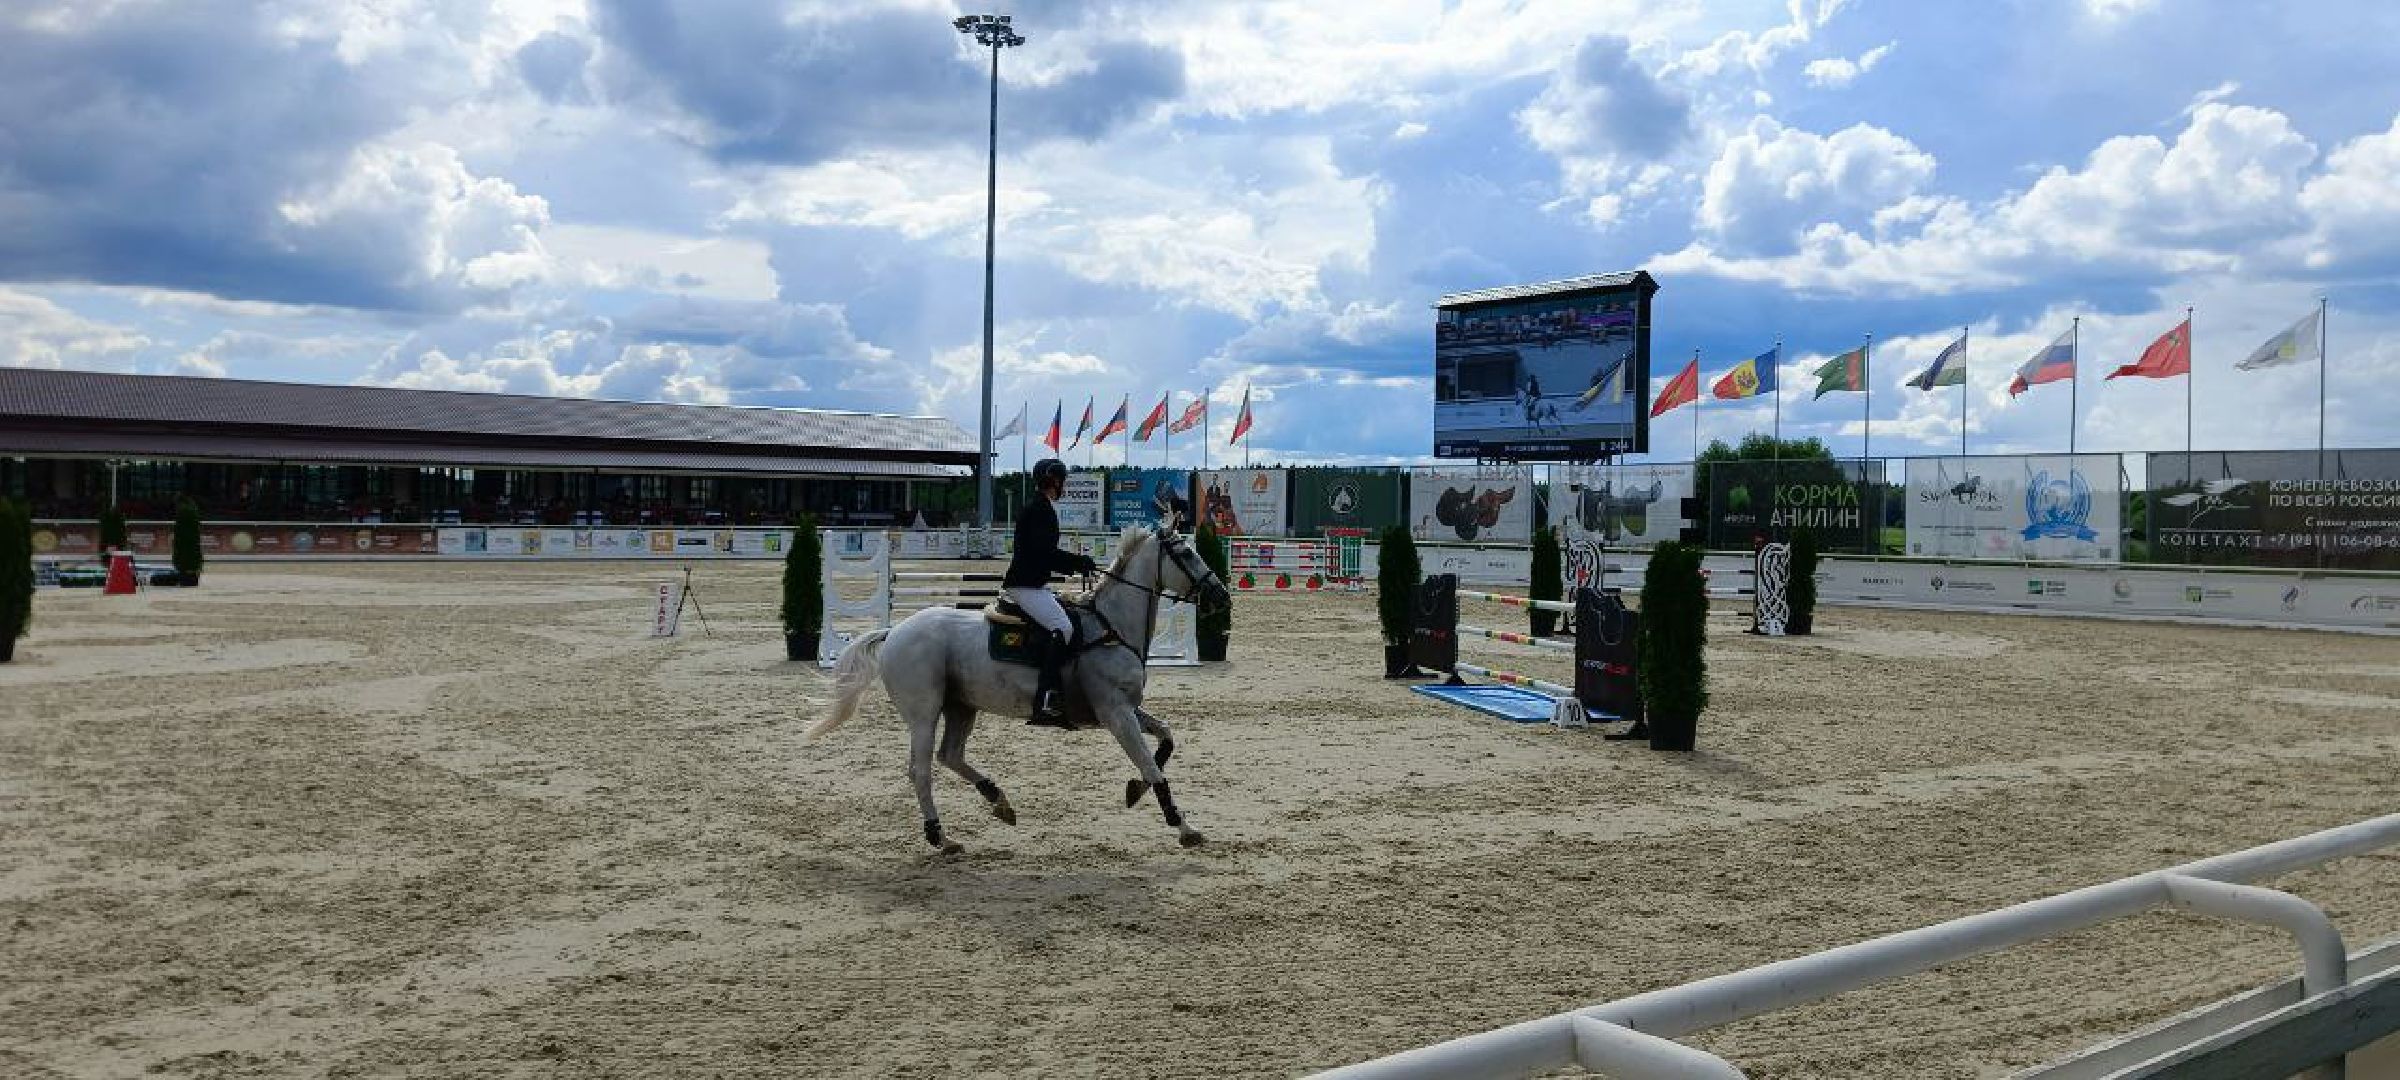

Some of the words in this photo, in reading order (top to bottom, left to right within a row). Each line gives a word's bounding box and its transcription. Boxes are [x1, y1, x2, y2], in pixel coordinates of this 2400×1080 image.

[1774, 484, 1859, 506] КОРМА
[2269, 494, 2292, 507] ПО
[2295, 492, 2335, 507] ВСЕЙ
[1770, 507, 1860, 528] АНИЛИН
[2269, 533, 2286, 547] +7
[1567, 703, 1581, 722] 10
